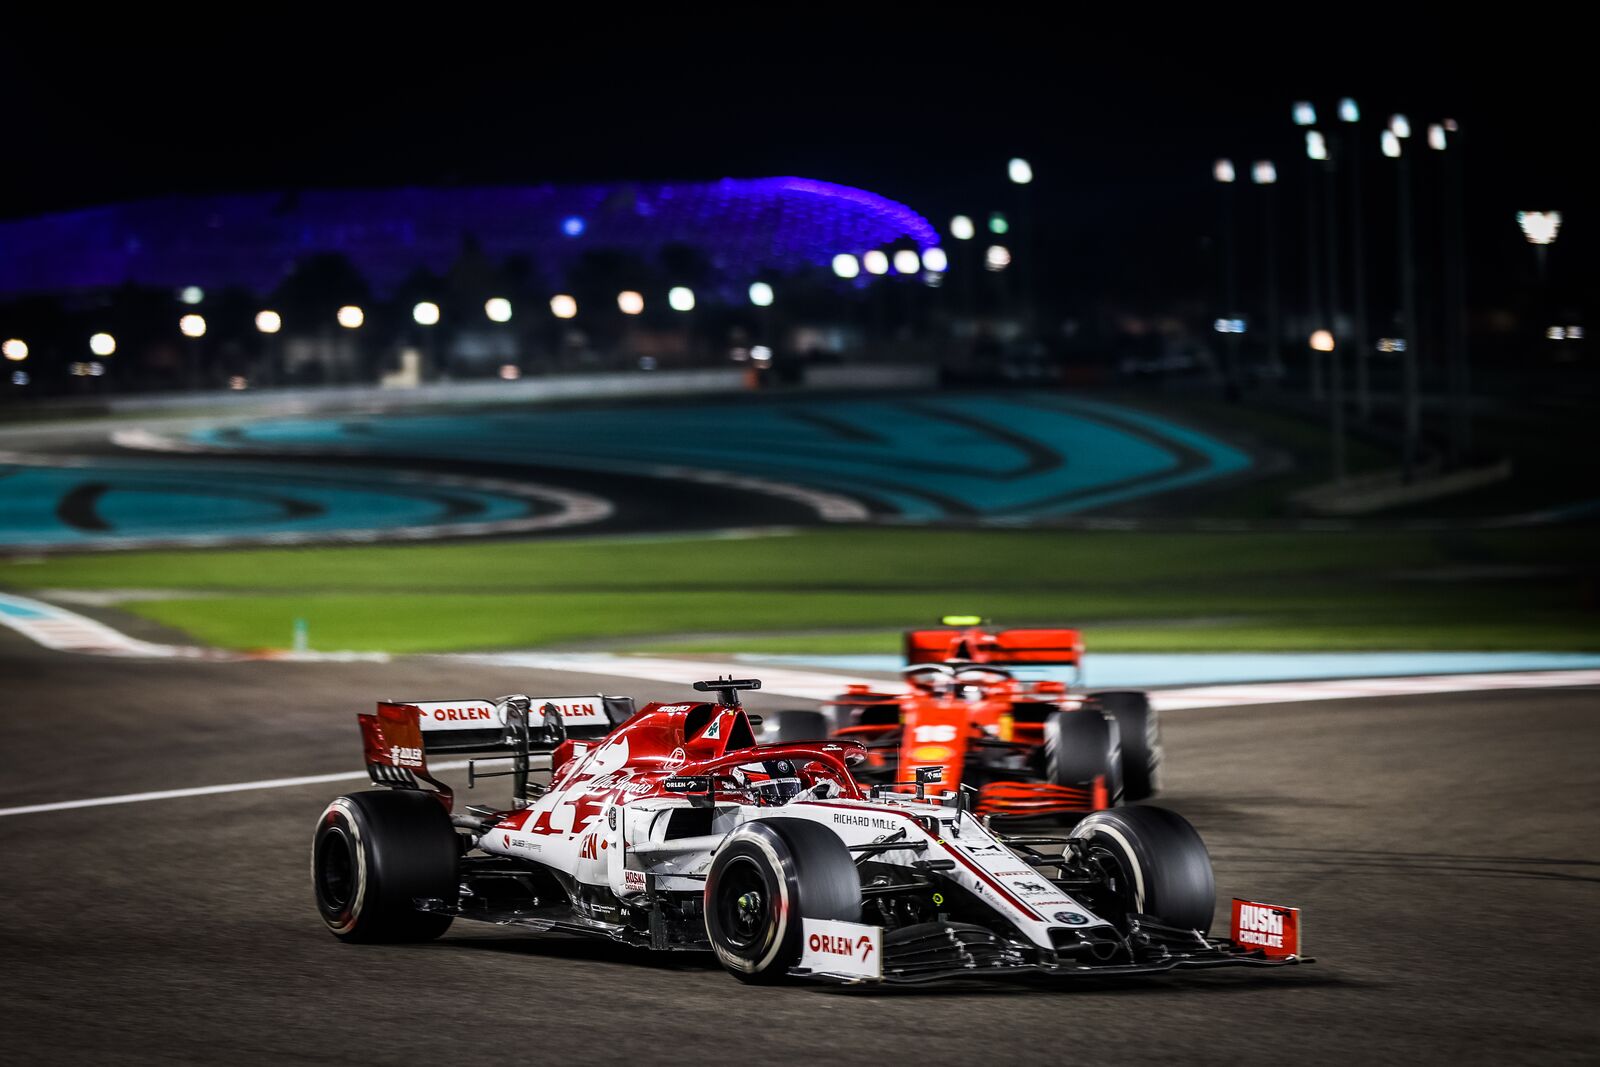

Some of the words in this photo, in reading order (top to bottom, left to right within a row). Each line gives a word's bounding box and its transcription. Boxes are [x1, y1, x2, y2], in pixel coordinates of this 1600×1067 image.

[434, 708, 491, 721] ORLEN
[833, 813, 869, 827] RICHARD
[1240, 904, 1283, 935] HUSKI
[809, 933, 852, 956] ORLEN
